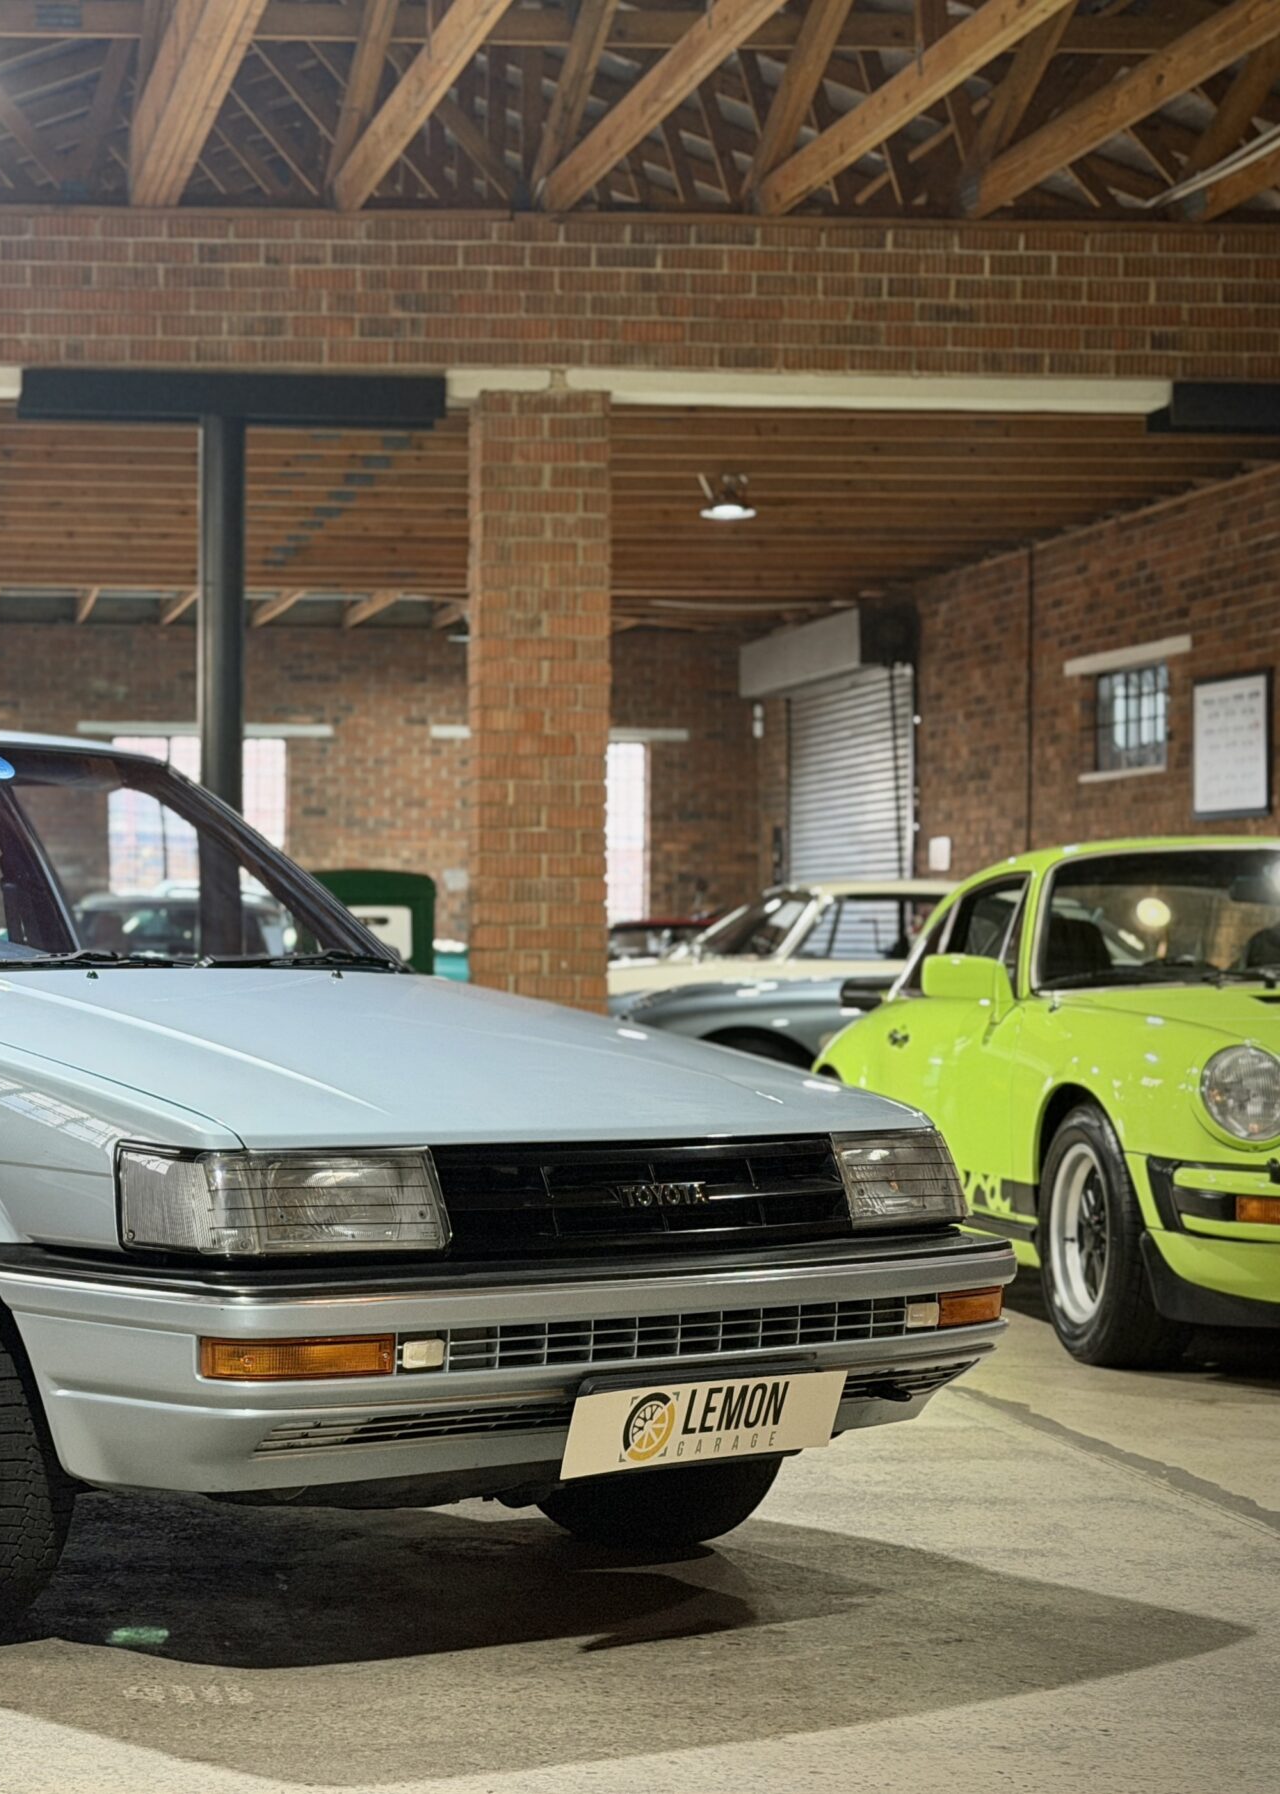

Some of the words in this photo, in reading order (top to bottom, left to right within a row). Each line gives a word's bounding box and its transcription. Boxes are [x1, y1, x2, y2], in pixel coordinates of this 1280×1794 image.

[620, 1183, 709, 1207] TOYOTA
[681, 1381, 790, 1435] LEMON
[676, 1431, 777, 1457] GARAGE
